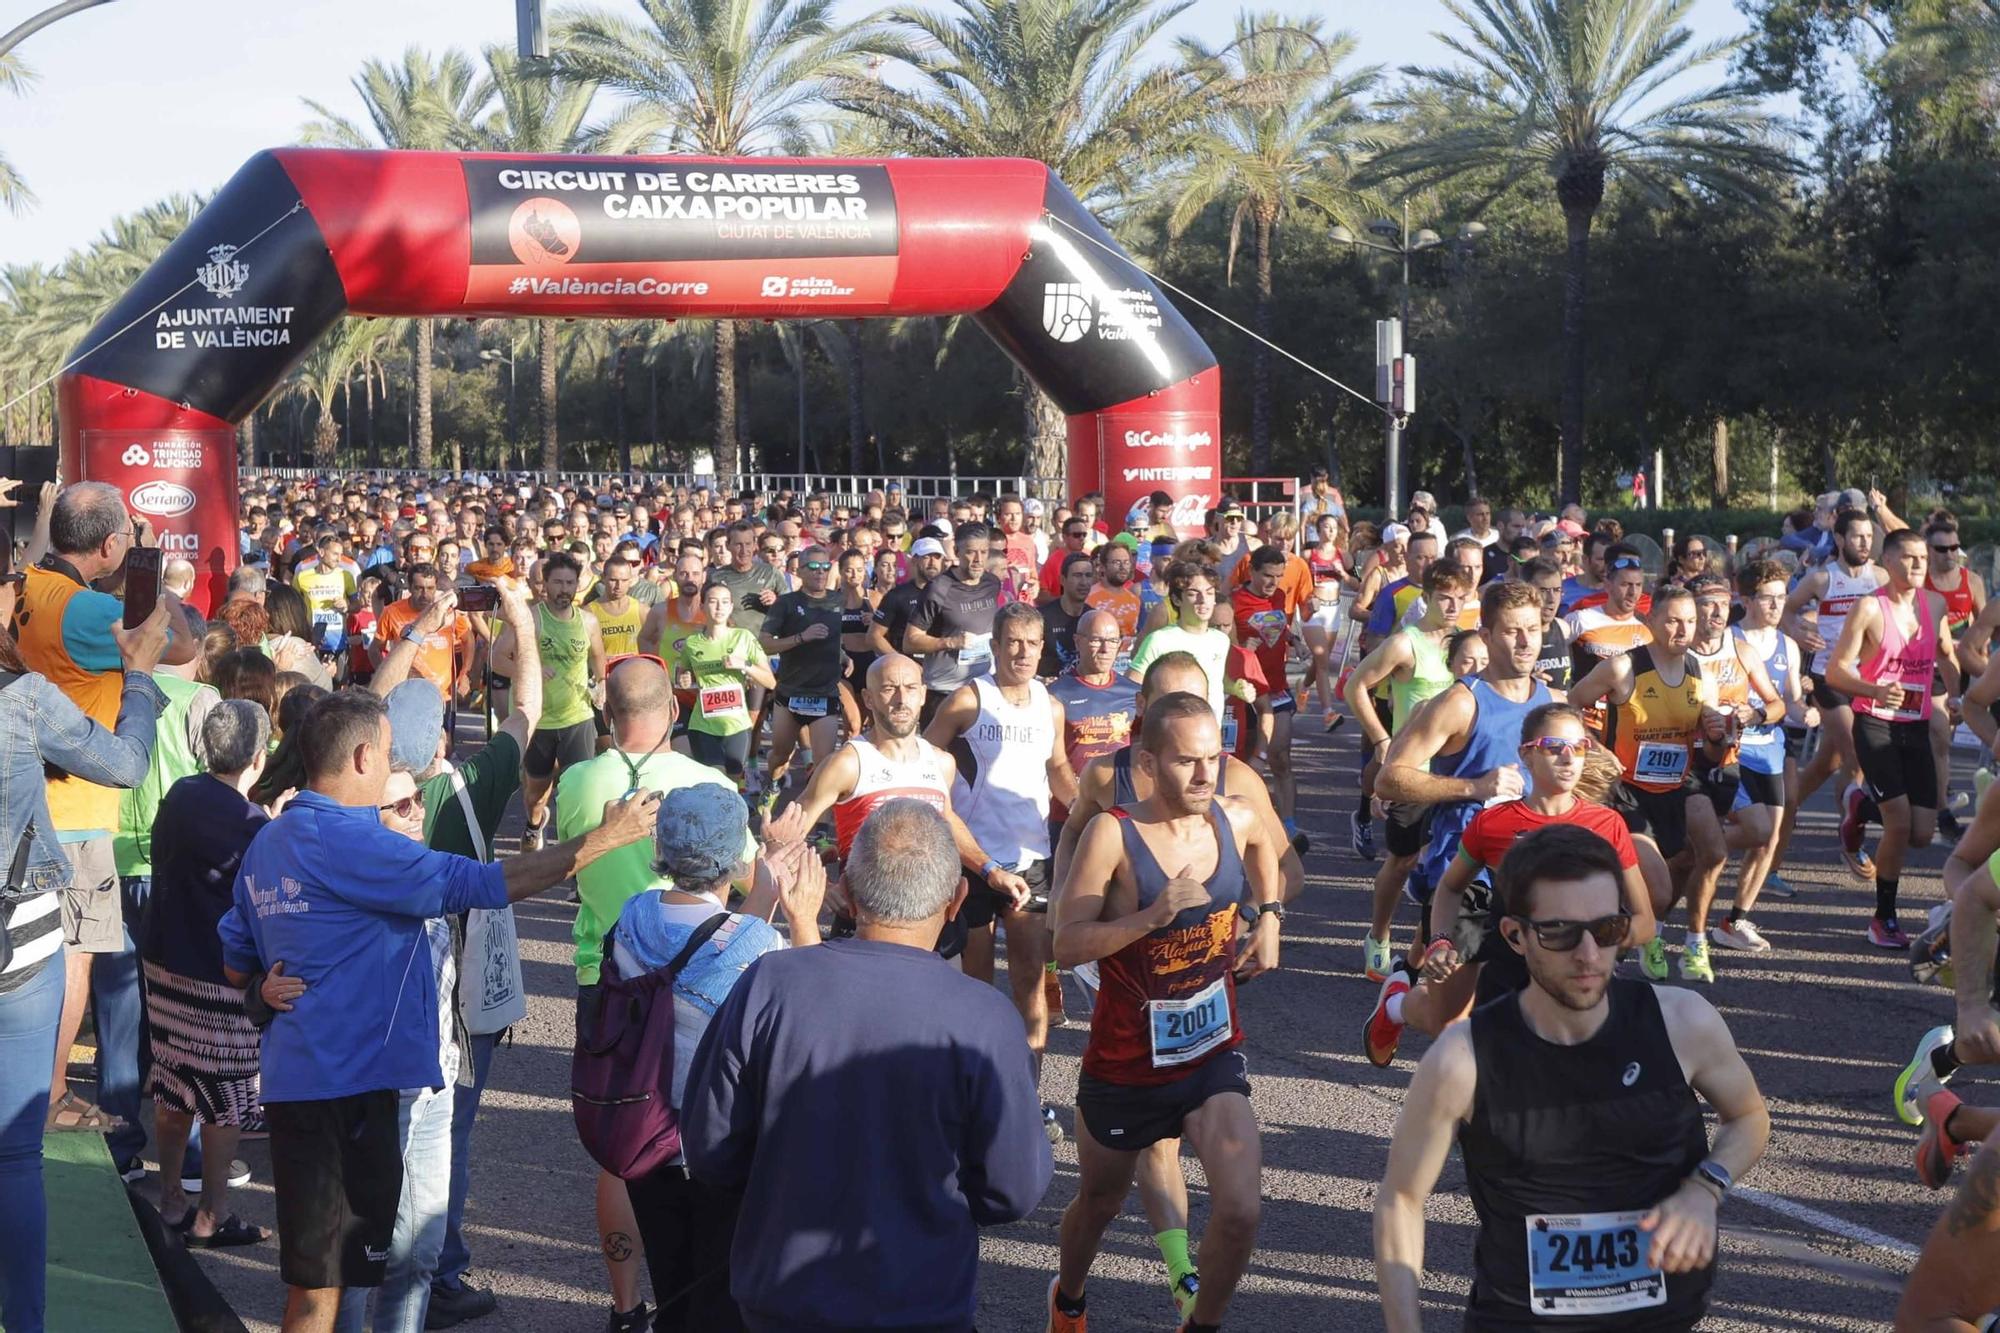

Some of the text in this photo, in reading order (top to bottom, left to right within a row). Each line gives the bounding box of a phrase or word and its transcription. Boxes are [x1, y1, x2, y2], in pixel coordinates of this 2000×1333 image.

[498, 169, 861, 194] CIRCUIT DE CARRERES
[718, 220, 872, 240] CIUTAT DE VALÈNCIA
[508, 276, 709, 295] #ValènciaCorre
[791, 276, 834, 287] caixa
[789, 285, 855, 298] popular
[156, 306, 295, 329] AJUNTAMENT
[156, 326, 291, 349] DE VALÈNCIA
[153, 449, 202, 459] TRINIDAD
[153, 459, 202, 469] ALFONSO
[139, 491, 190, 506] Serrano
[706, 690, 736, 706] 2848
[979, 723, 1033, 744] CORATGE
[1647, 750, 1680, 768] 2197
[1166, 999, 1216, 1038] 2001
[1548, 1228, 1639, 1272] 2443
